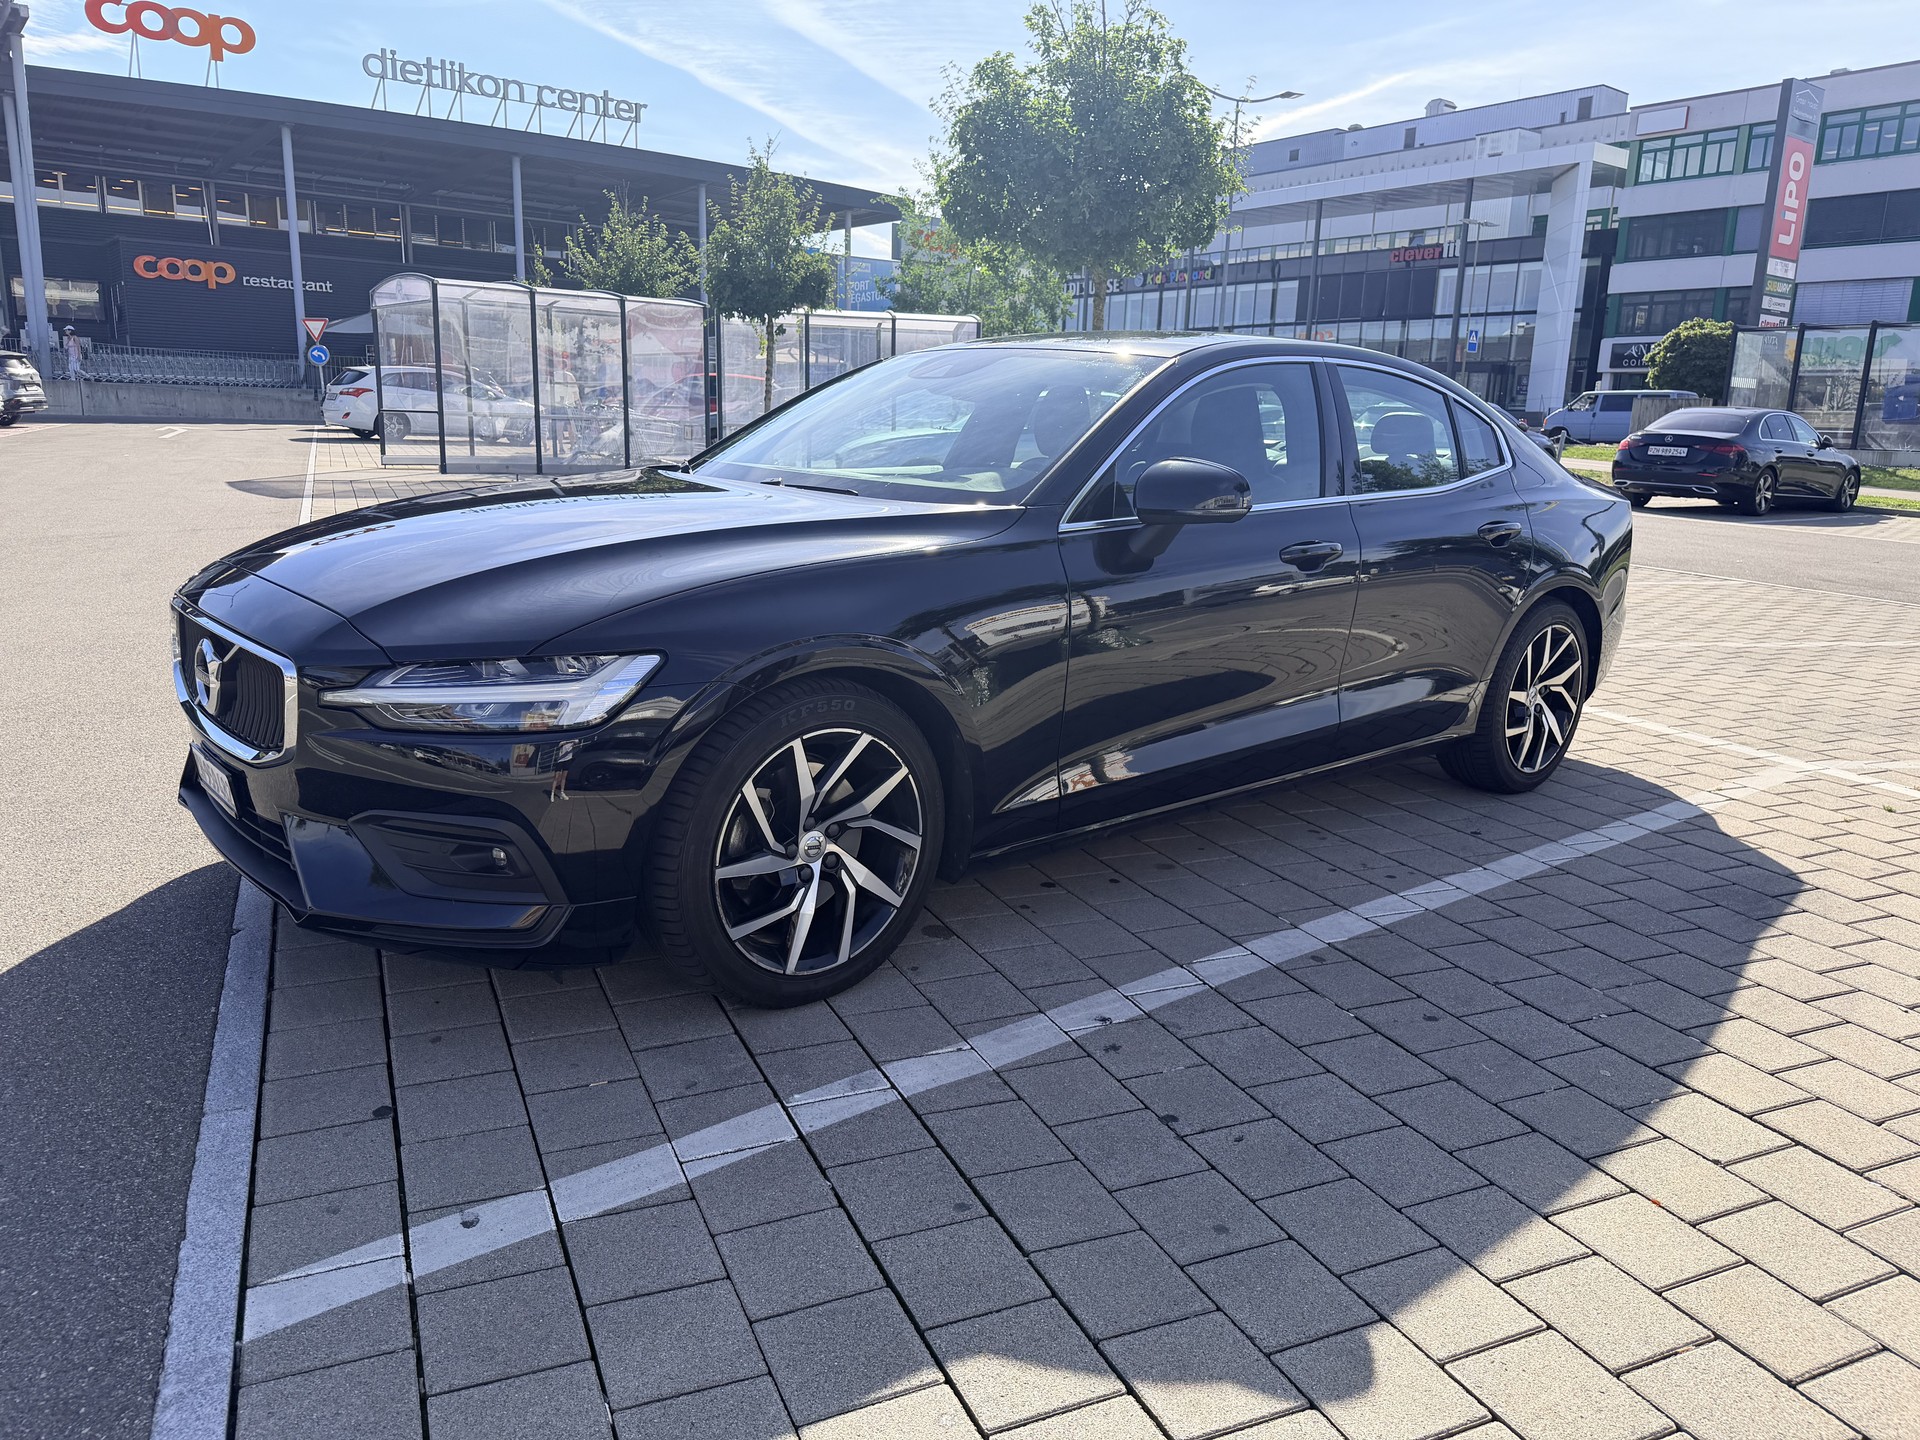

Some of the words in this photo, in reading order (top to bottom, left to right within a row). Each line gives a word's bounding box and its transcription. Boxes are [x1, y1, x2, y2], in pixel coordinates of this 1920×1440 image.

[84, 0, 256, 62] coop
[362, 48, 525, 103] dietlikon
[537, 90, 648, 123] center
[133, 255, 236, 289] coop
[1169, 267, 1212, 284] Playand
